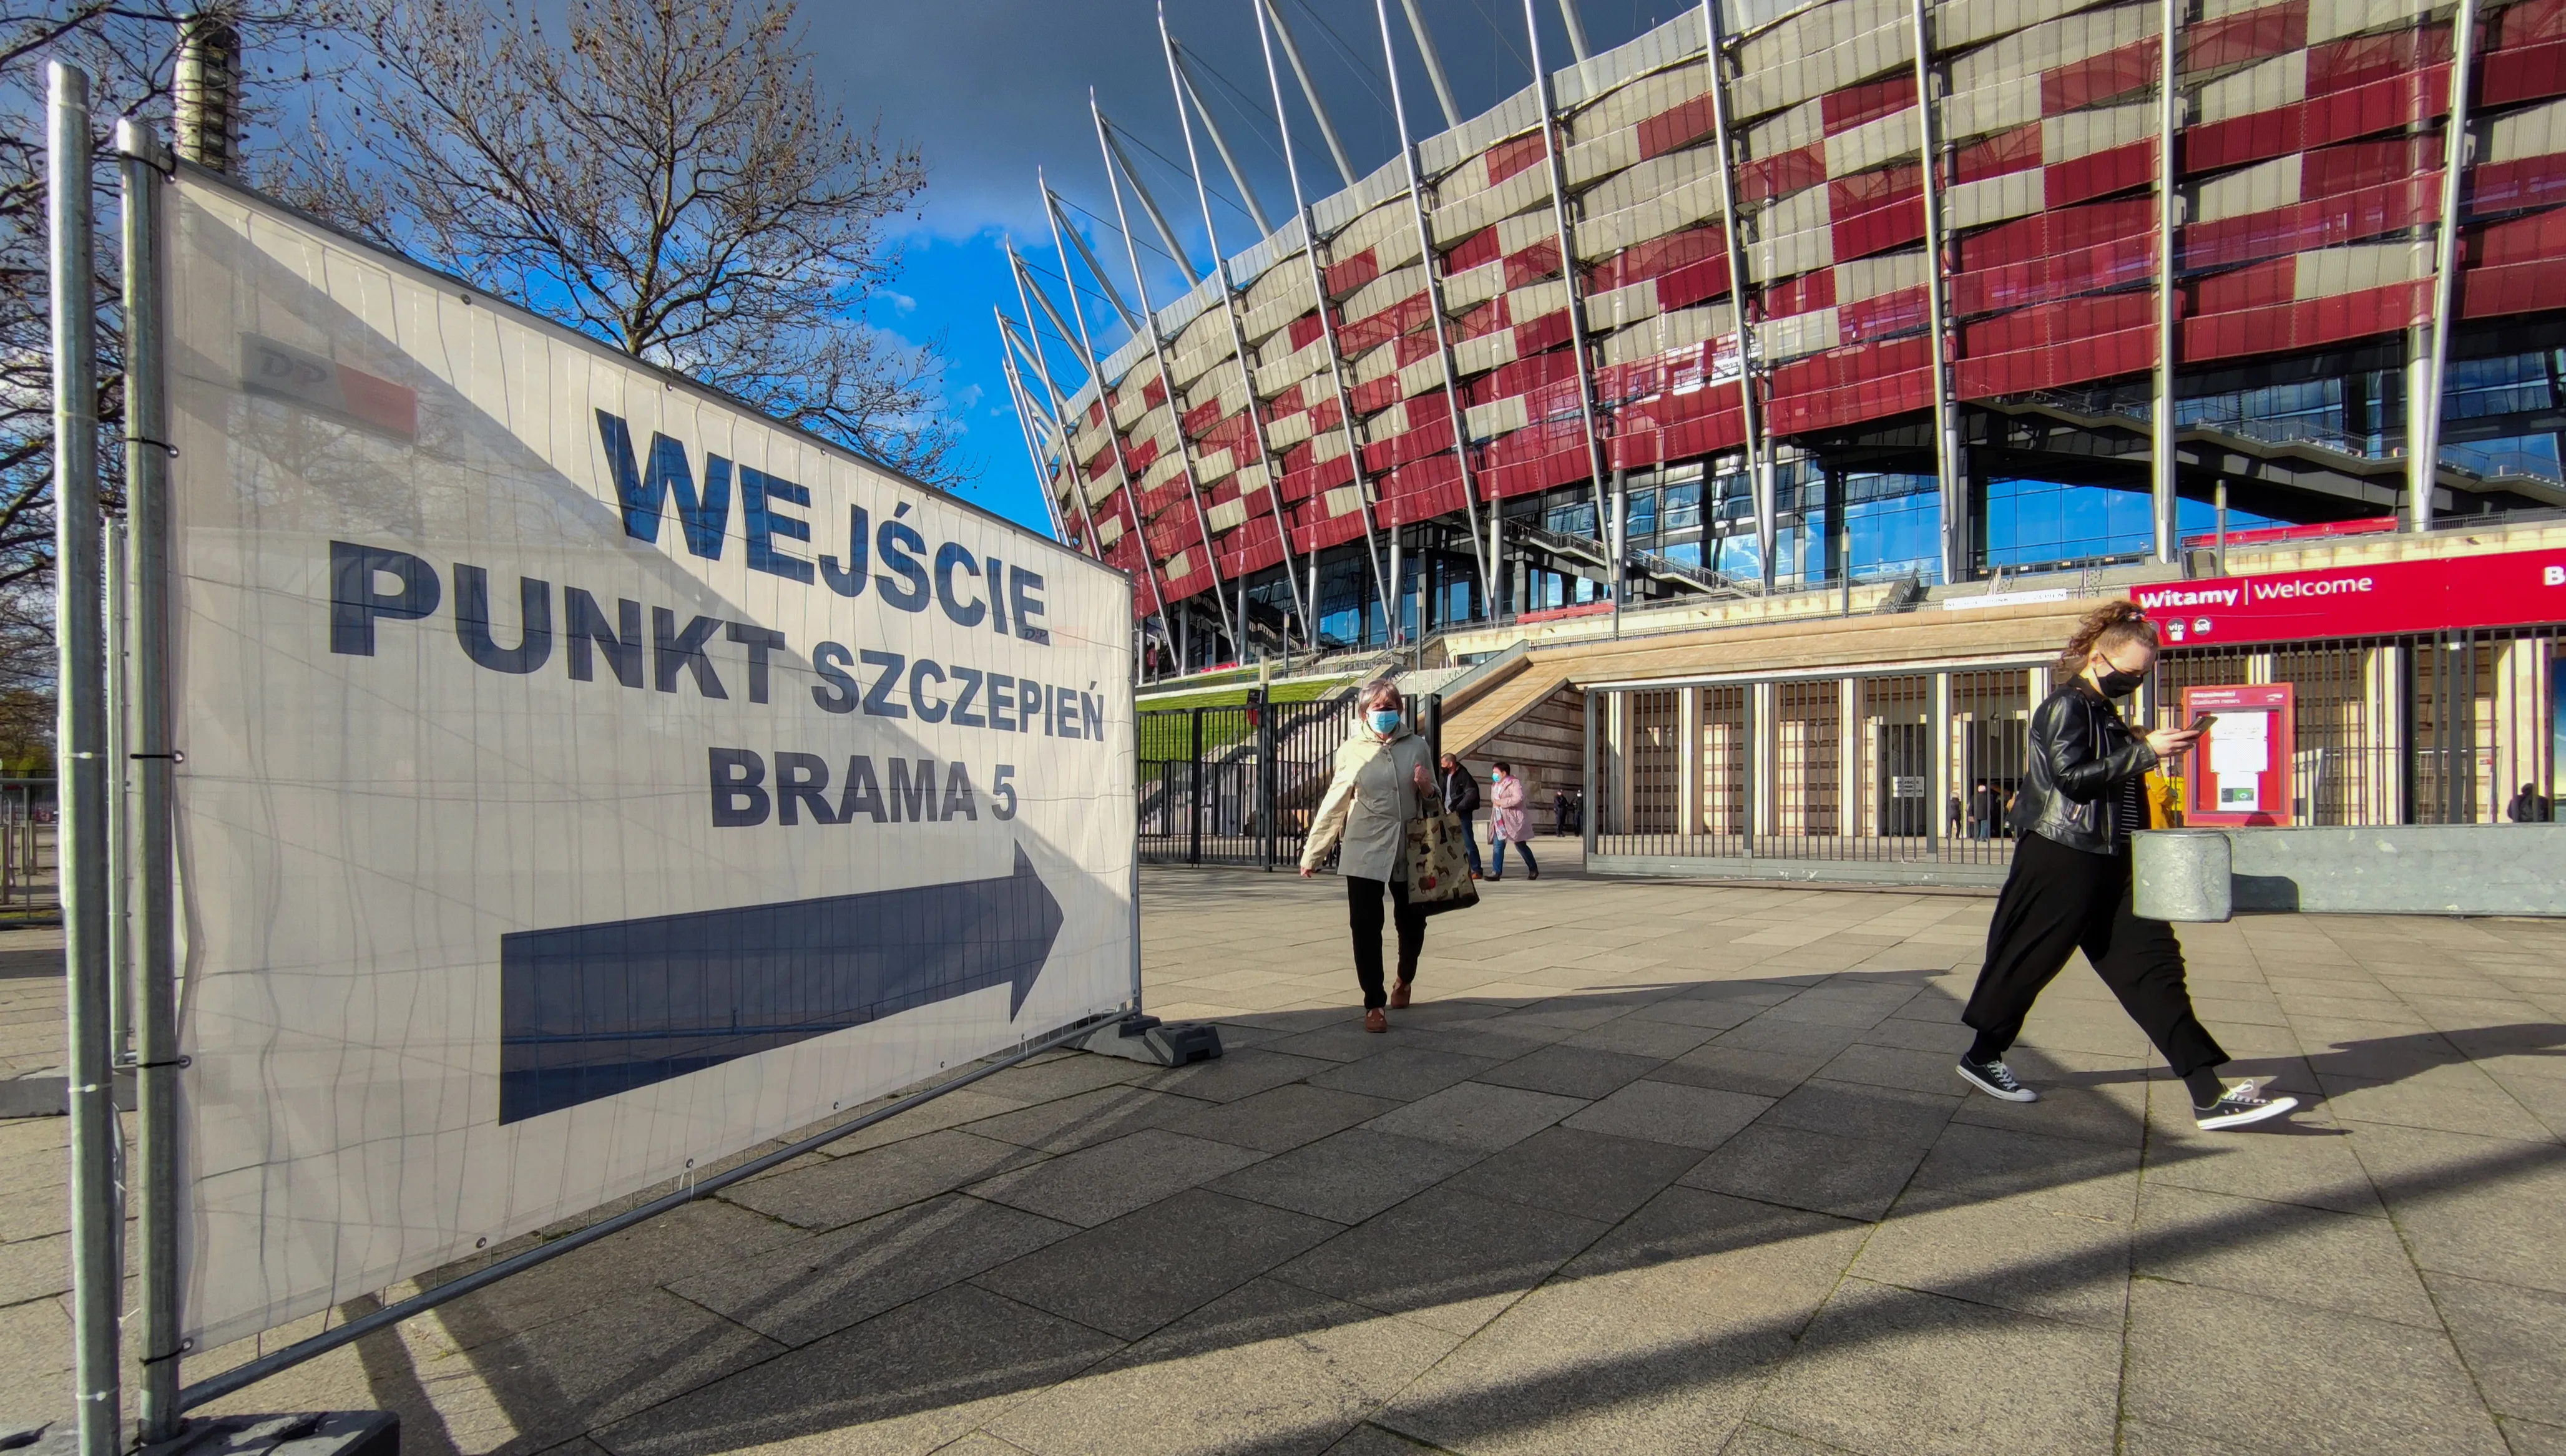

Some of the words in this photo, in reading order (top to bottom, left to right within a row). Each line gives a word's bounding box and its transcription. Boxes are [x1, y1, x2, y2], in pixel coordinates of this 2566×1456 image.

[595, 408, 1050, 645] WEJŚCIE
[2140, 589, 2238, 608] Witamy
[2255, 577, 2373, 600] Welcome
[2168, 624, 2184, 633] vip
[330, 540, 786, 705] PUNKT
[811, 641, 1104, 741] SZCZEPIEŃ
[708, 747, 977, 827] BRAMA
[991, 765, 1017, 821] 5
